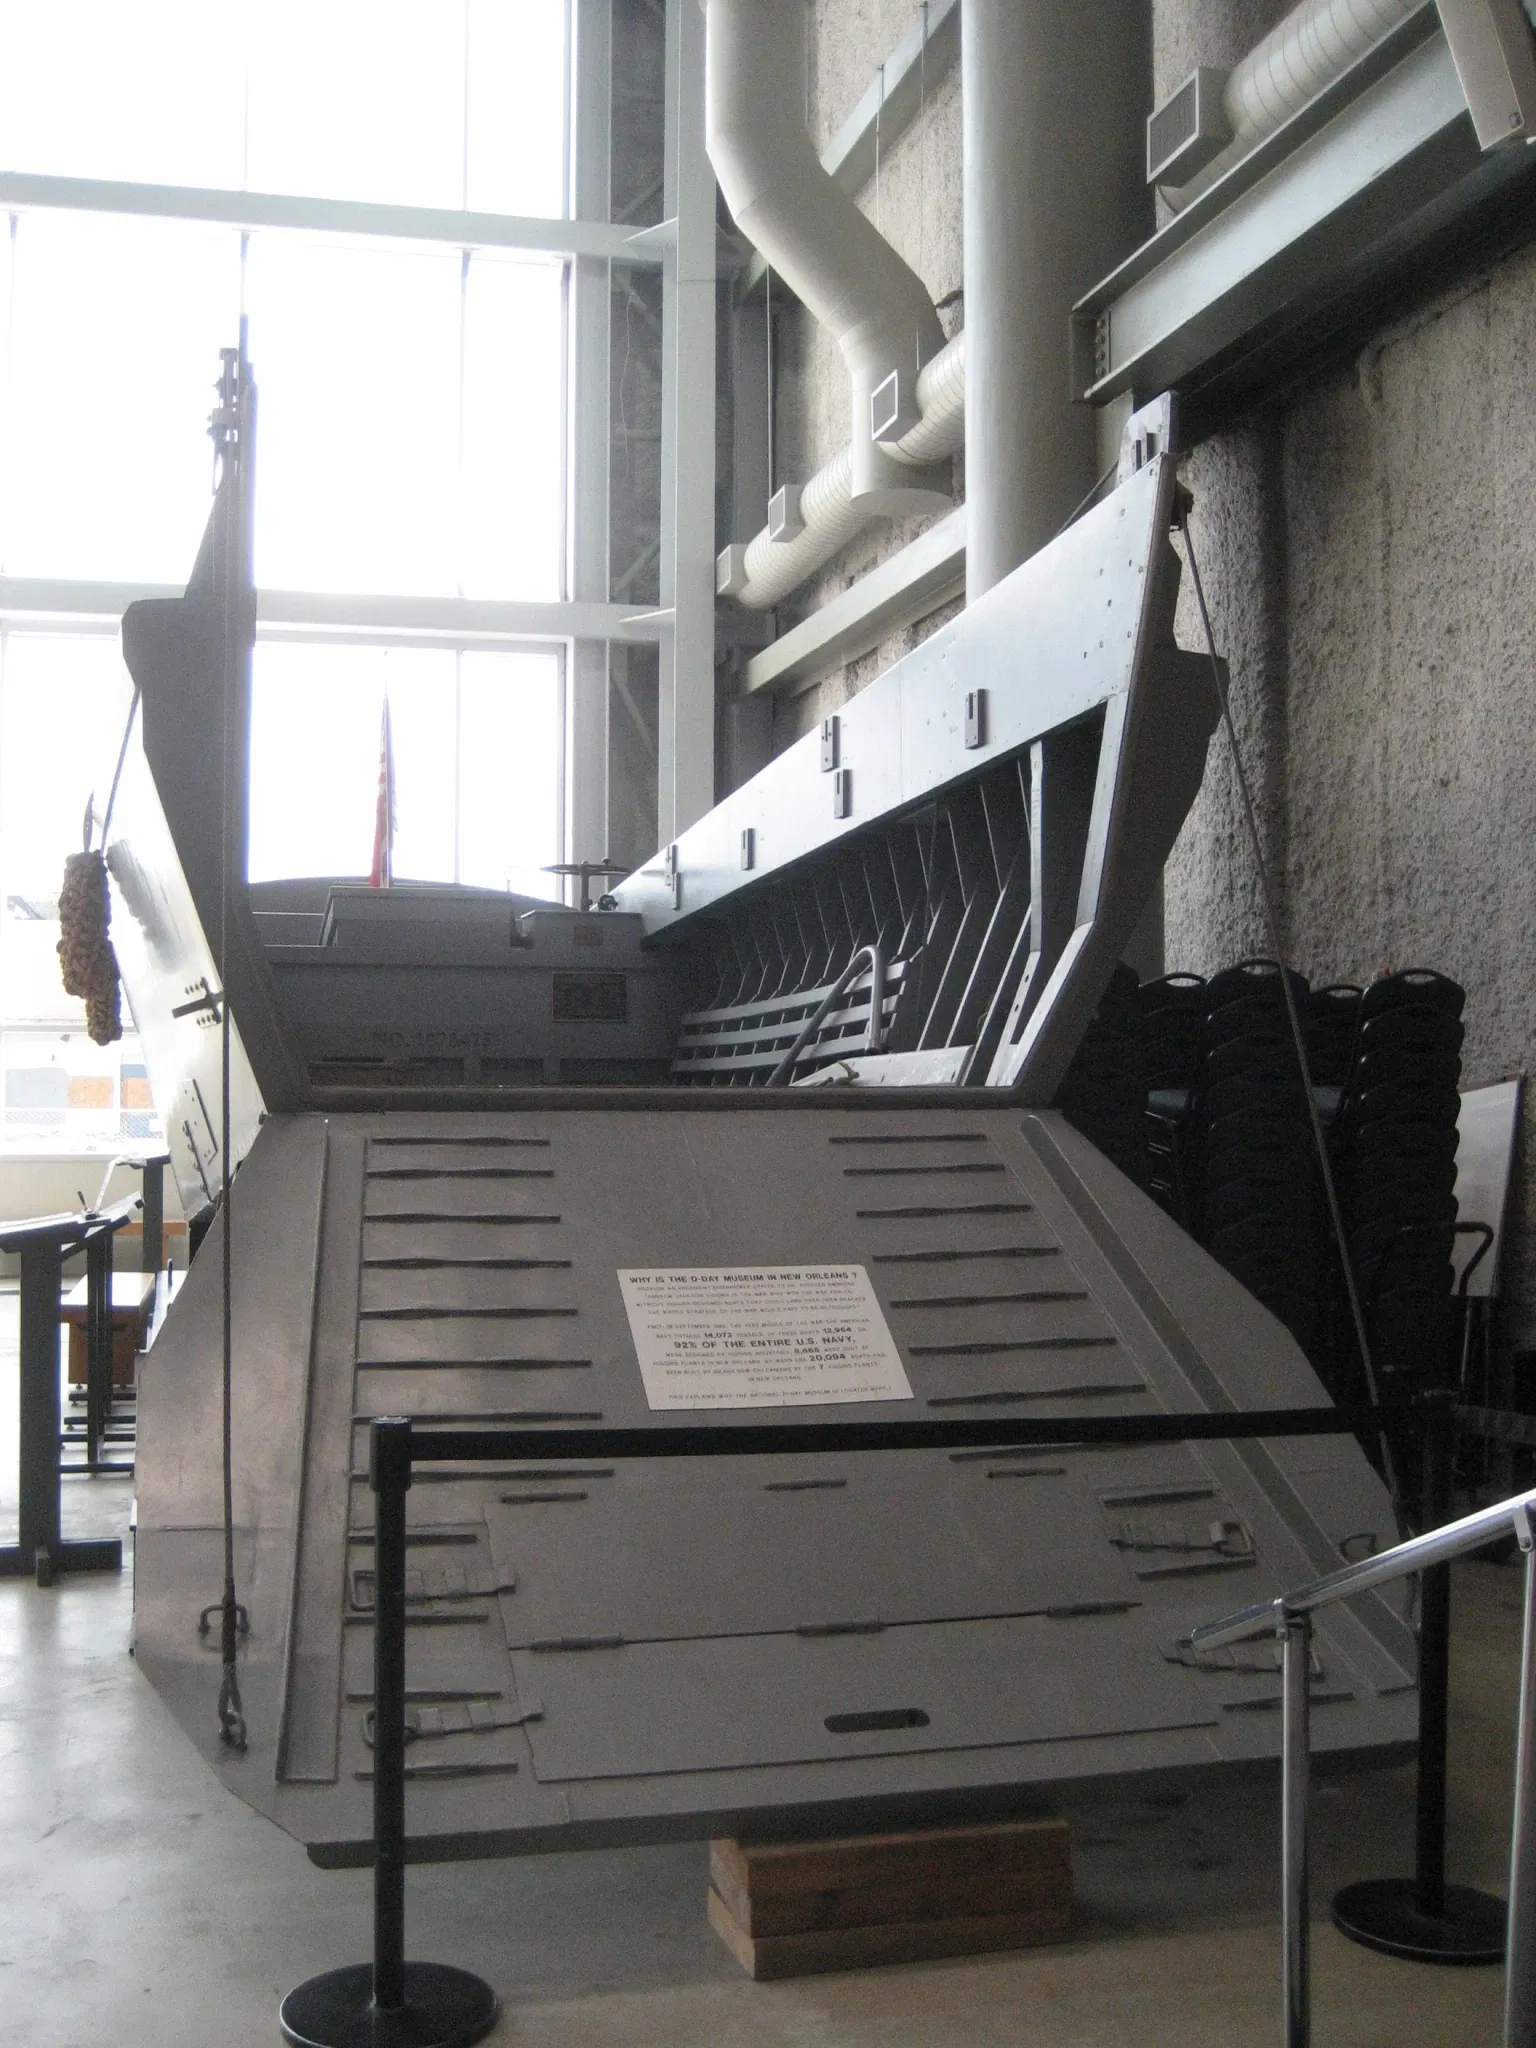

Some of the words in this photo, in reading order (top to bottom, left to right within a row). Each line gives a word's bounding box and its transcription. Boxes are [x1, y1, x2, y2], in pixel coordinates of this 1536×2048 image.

[629, 1276, 651, 1284] WHY
[668, 1275, 687, 1283] THE
[690, 1275, 719, 1283] D-DAY
[723, 1274, 764, 1282] MUSEUM
[767, 1273, 777, 1281] IN
[780, 1273, 801, 1281] NEW
[805, 1272, 848, 1280] ORLEANS
[704, 1331, 733, 1339] 14,072
[673, 1340, 699, 1349] 92%
[702, 1340, 718, 1349] OF
[722, 1339, 746, 1348] THE
[750, 1337, 793, 1348] ENTIRE
[796, 1337, 819, 1346] U.S.
[822, 1335, 856, 1345] NAVY,
